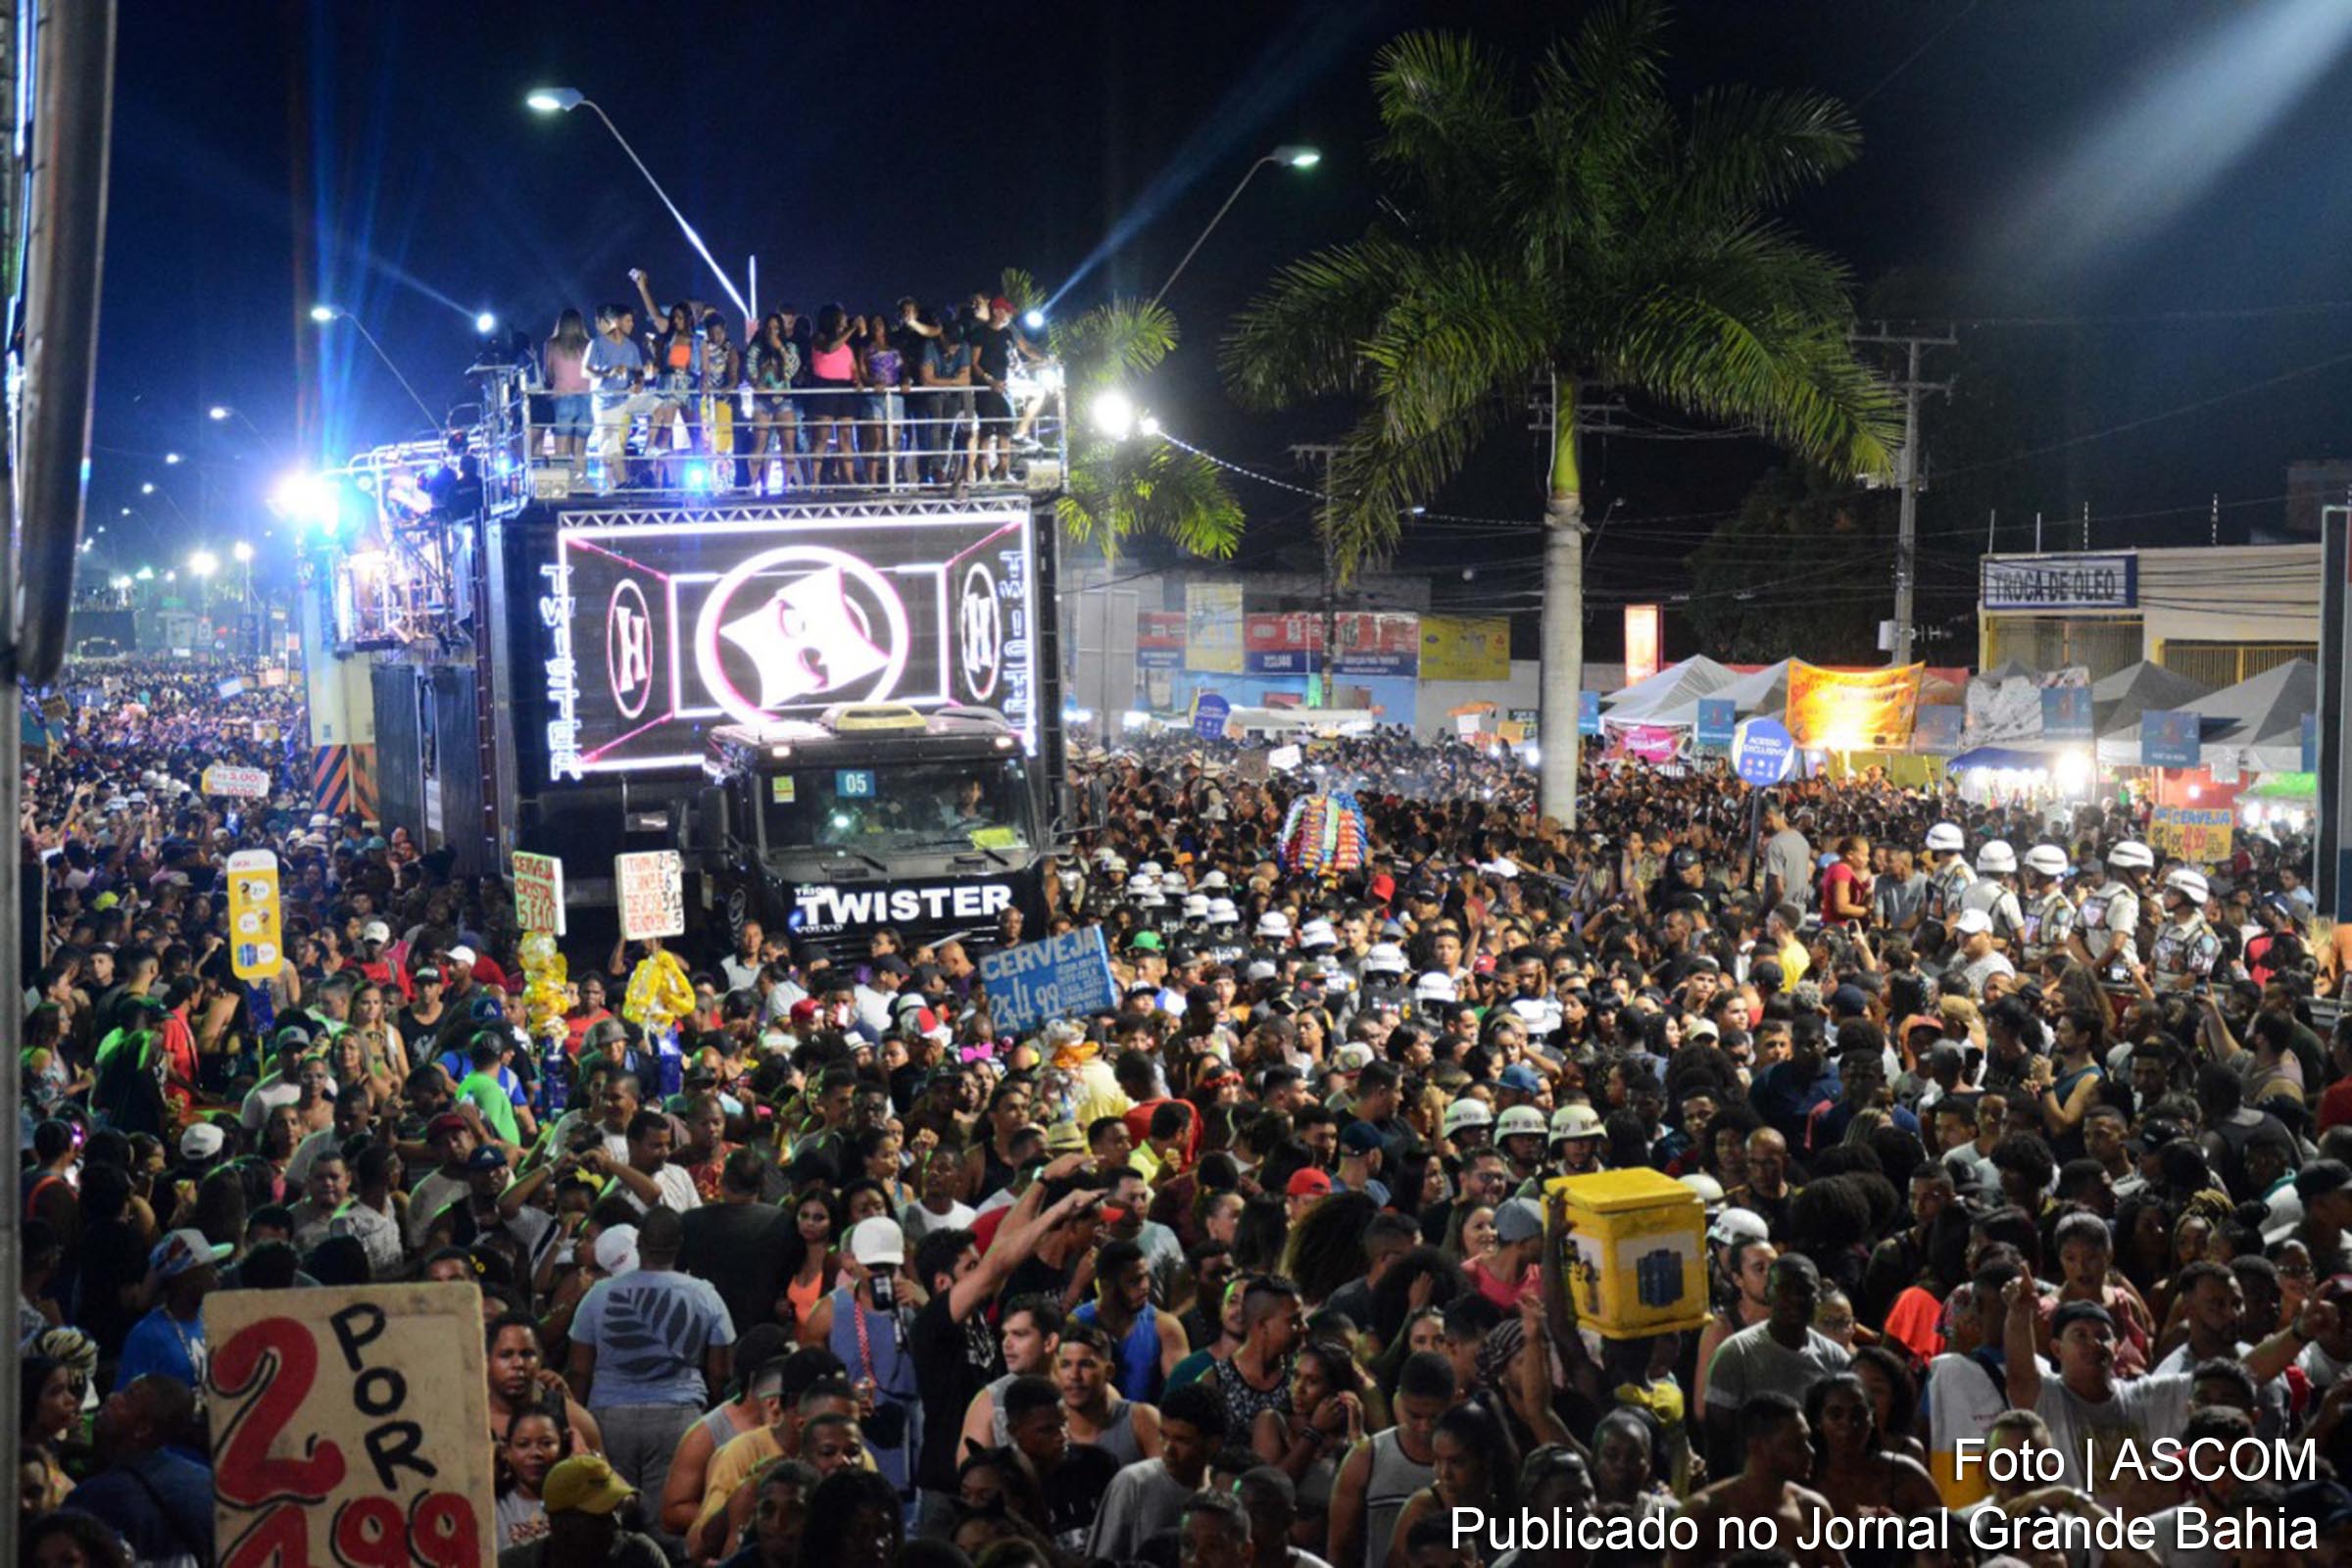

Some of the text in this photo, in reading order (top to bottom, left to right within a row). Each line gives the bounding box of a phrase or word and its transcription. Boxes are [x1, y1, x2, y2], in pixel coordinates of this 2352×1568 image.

[1994, 569, 2045, 602] TROCA
[2049, 569, 2070, 602] DE
[845, 772, 867, 794] 05
[2171, 809, 2231, 825] CERVEJA
[796, 885, 1012, 926] TWISTER
[794, 922, 844, 935] VOLVO
[979, 926, 1101, 981] CERVEJA
[206, 1302, 438, 1511] 2 POR
